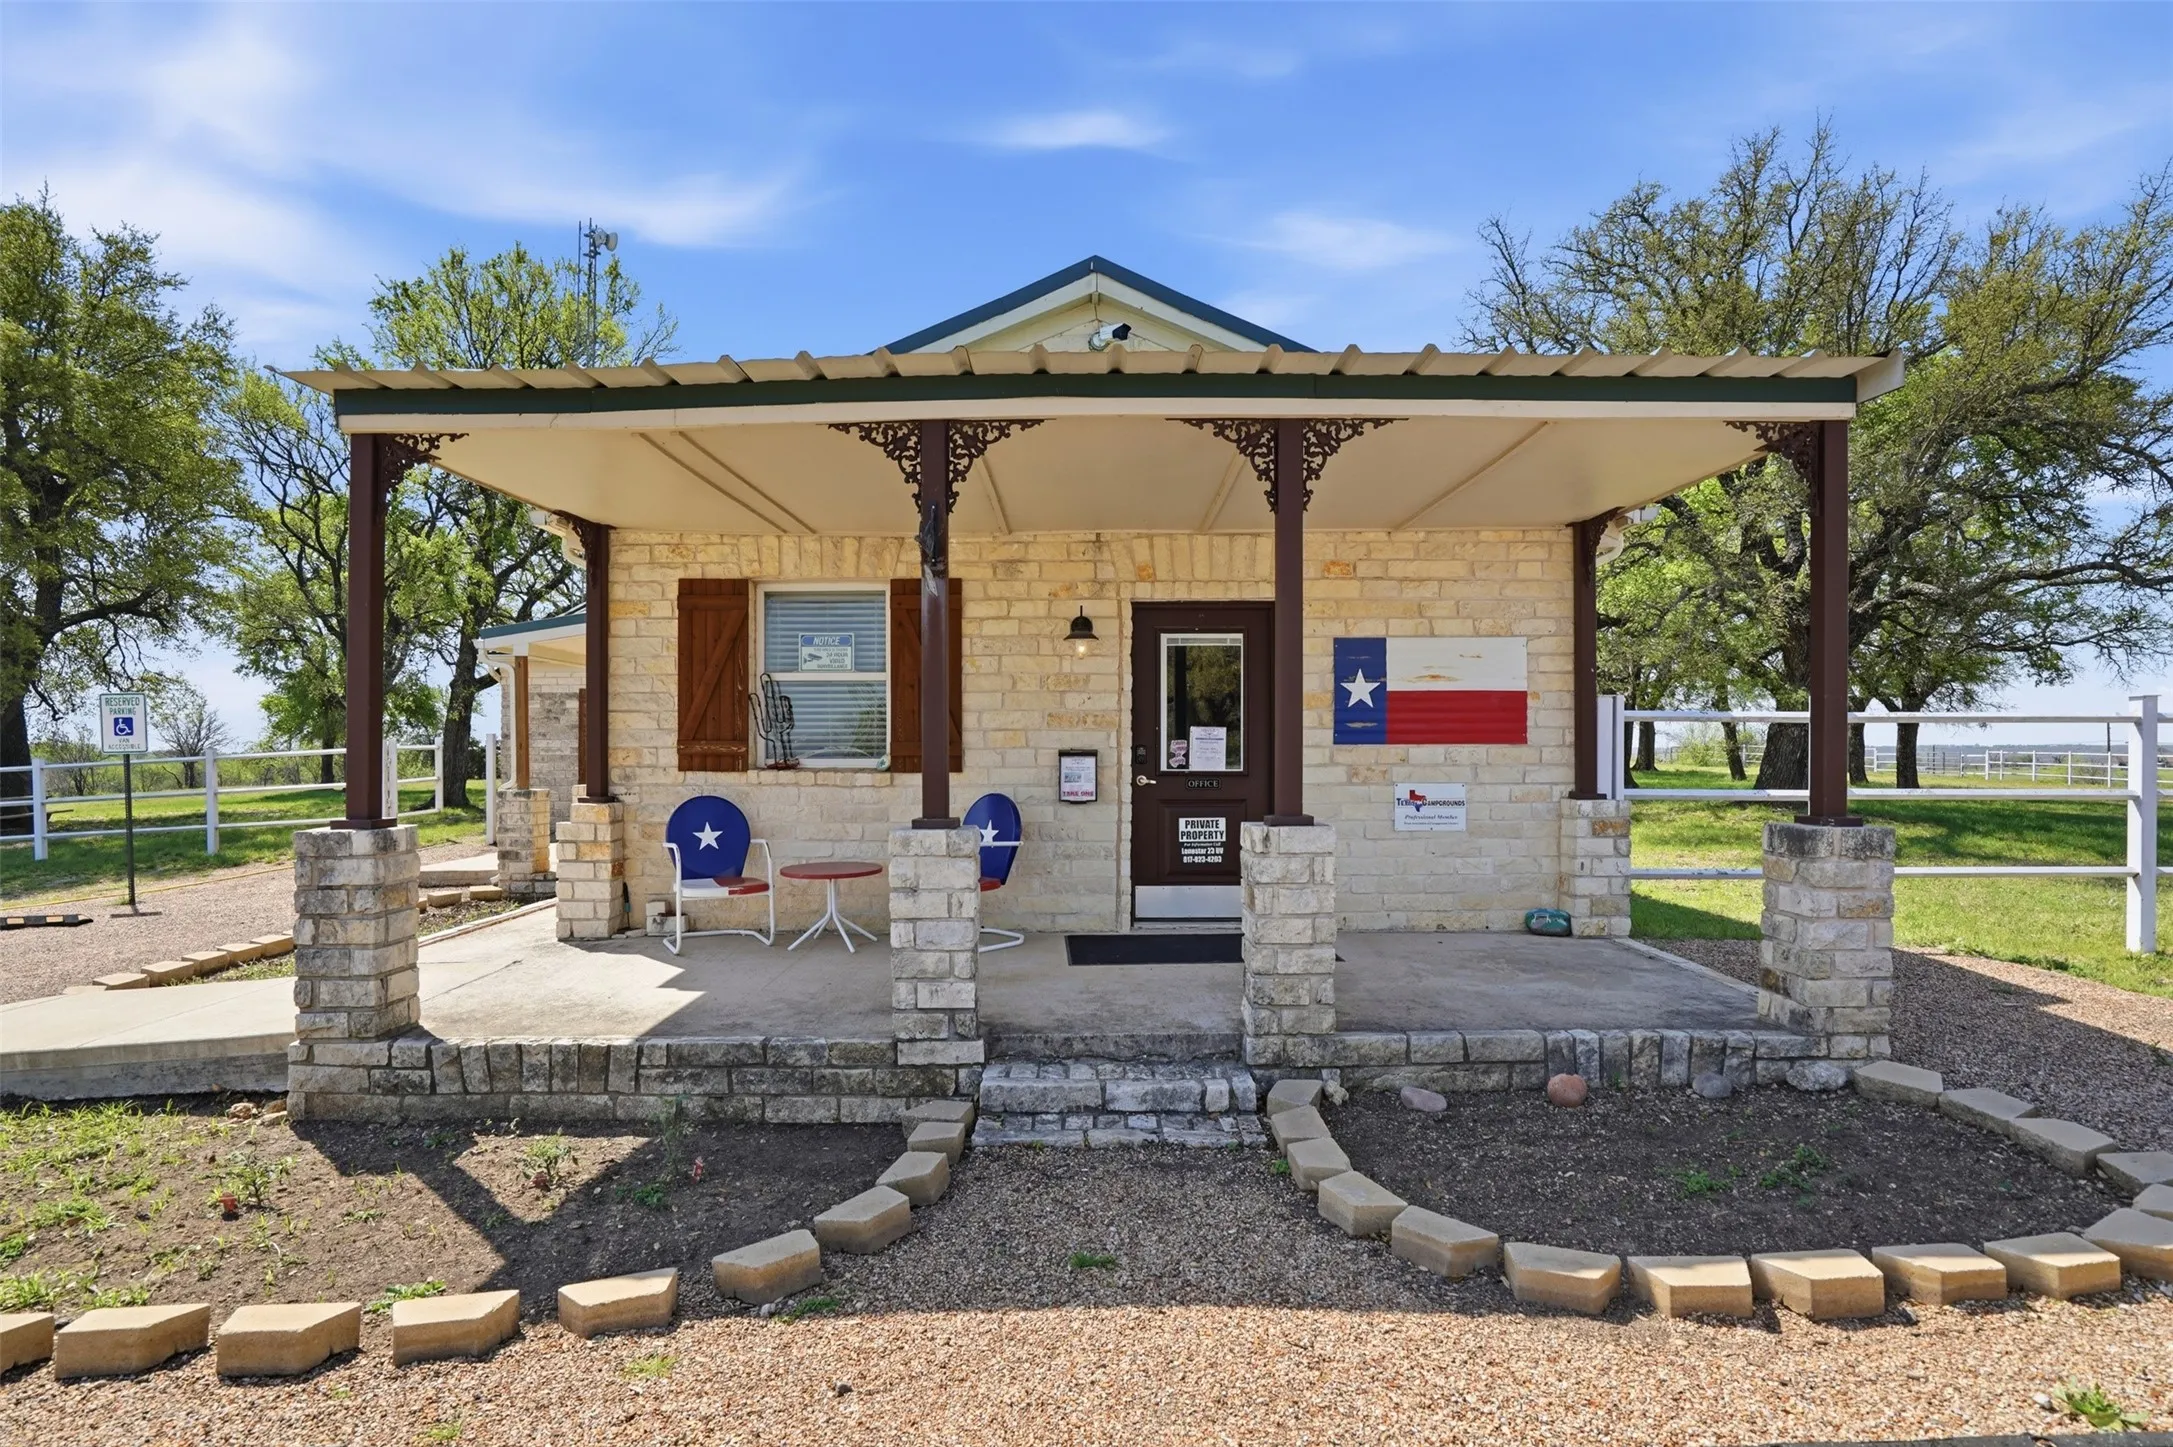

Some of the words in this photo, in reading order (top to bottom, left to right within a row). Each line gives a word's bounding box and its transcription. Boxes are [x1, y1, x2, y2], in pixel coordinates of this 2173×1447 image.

[813, 635, 841, 646] NOTICE
[105, 697, 140, 707] RESERVED
[109, 707, 137, 716] PARKING
[1188, 780, 1219, 788] OFFICE
[1422, 798, 1466, 807] CAMPGROUNDS
[1185, 820, 1220, 829] PRIVATE
[1180, 830, 1225, 840] PROPERTY
